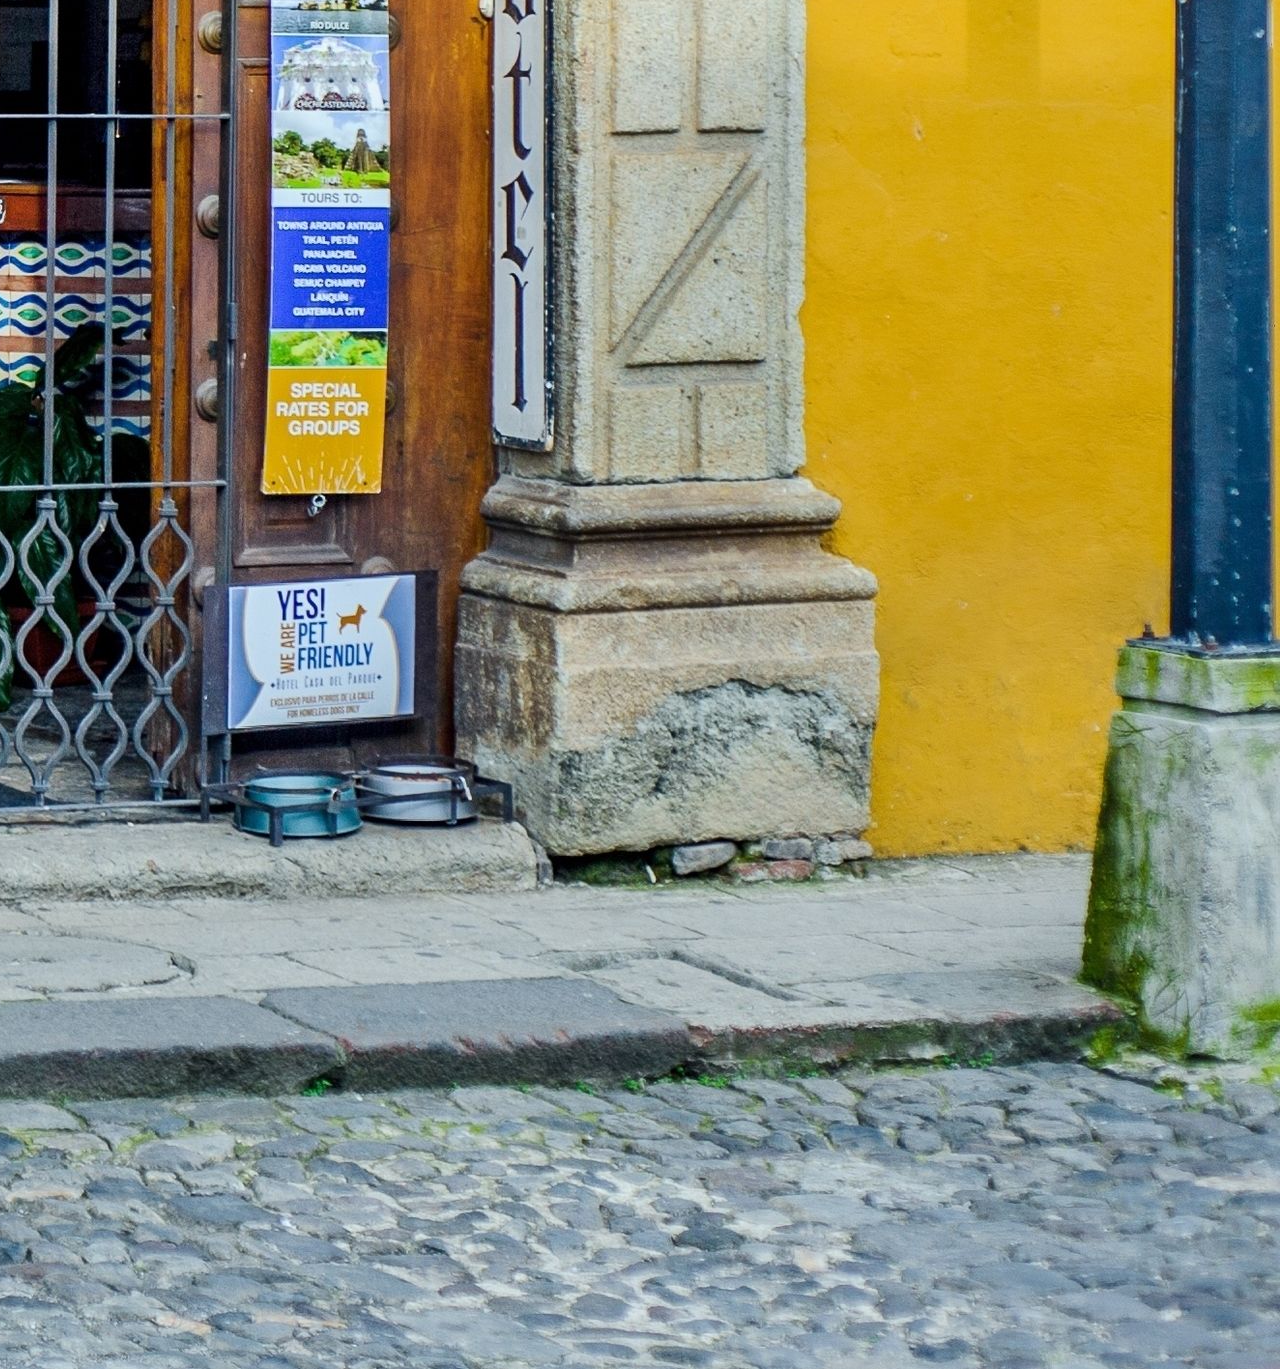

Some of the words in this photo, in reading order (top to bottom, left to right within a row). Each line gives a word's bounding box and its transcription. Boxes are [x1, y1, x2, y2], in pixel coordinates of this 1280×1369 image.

[326, 21, 350, 30] DULCE
[301, 192, 340, 203] TOURS
[344, 193, 362, 203] TO:
[345, 307, 365, 316] CITY
[291, 383, 361, 398] SPECIAL
[276, 402, 329, 417] RATES
[334, 402, 368, 417] FOR
[288, 420, 360, 436] GROUPS
[278, 588, 325, 620] YES!
[281, 622, 296, 648] ARE
[298, 621, 327, 645] PET
[280, 653, 295, 675] WE
[298, 643, 373, 670] FRIENDLY
